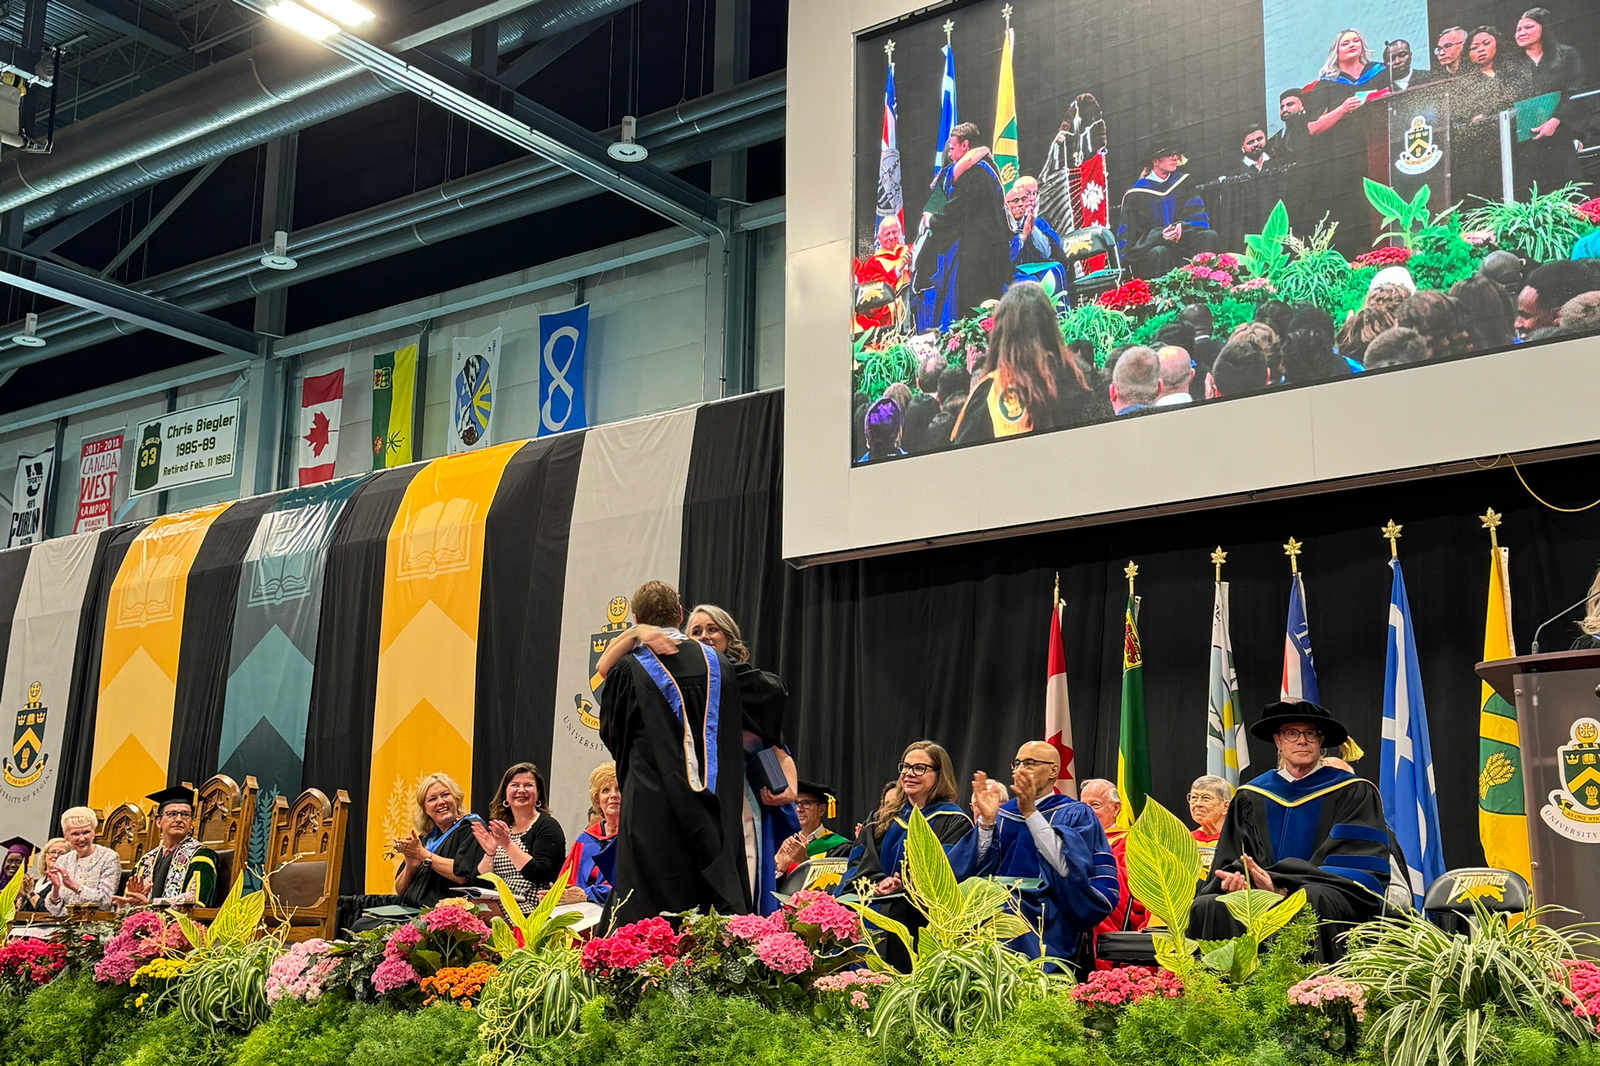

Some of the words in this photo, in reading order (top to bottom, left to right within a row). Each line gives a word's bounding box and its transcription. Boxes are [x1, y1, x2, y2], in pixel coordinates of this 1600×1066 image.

[167, 422, 193, 439] Chris
[196, 414, 235, 432] Biegler
[140, 446, 157, 468] 33
[176, 436, 216, 457] 1985-89
[82, 452, 118, 475] CANADA
[163, 462, 188, 476] Retired
[190, 459, 205, 470] Feb.
[207, 457, 213, 467] 11
[215, 453, 231, 465] 1989
[81, 471, 118, 501] WEST
[563, 715, 605, 751] UNIVERSIT
[0, 785, 20, 804] VERSITY
[23, 794, 30, 802] OF
[32, 769, 53, 797] REGINA
[1545, 810, 1598, 838] UNIVERSITY
[1446, 875, 1509, 905] COUGARS
